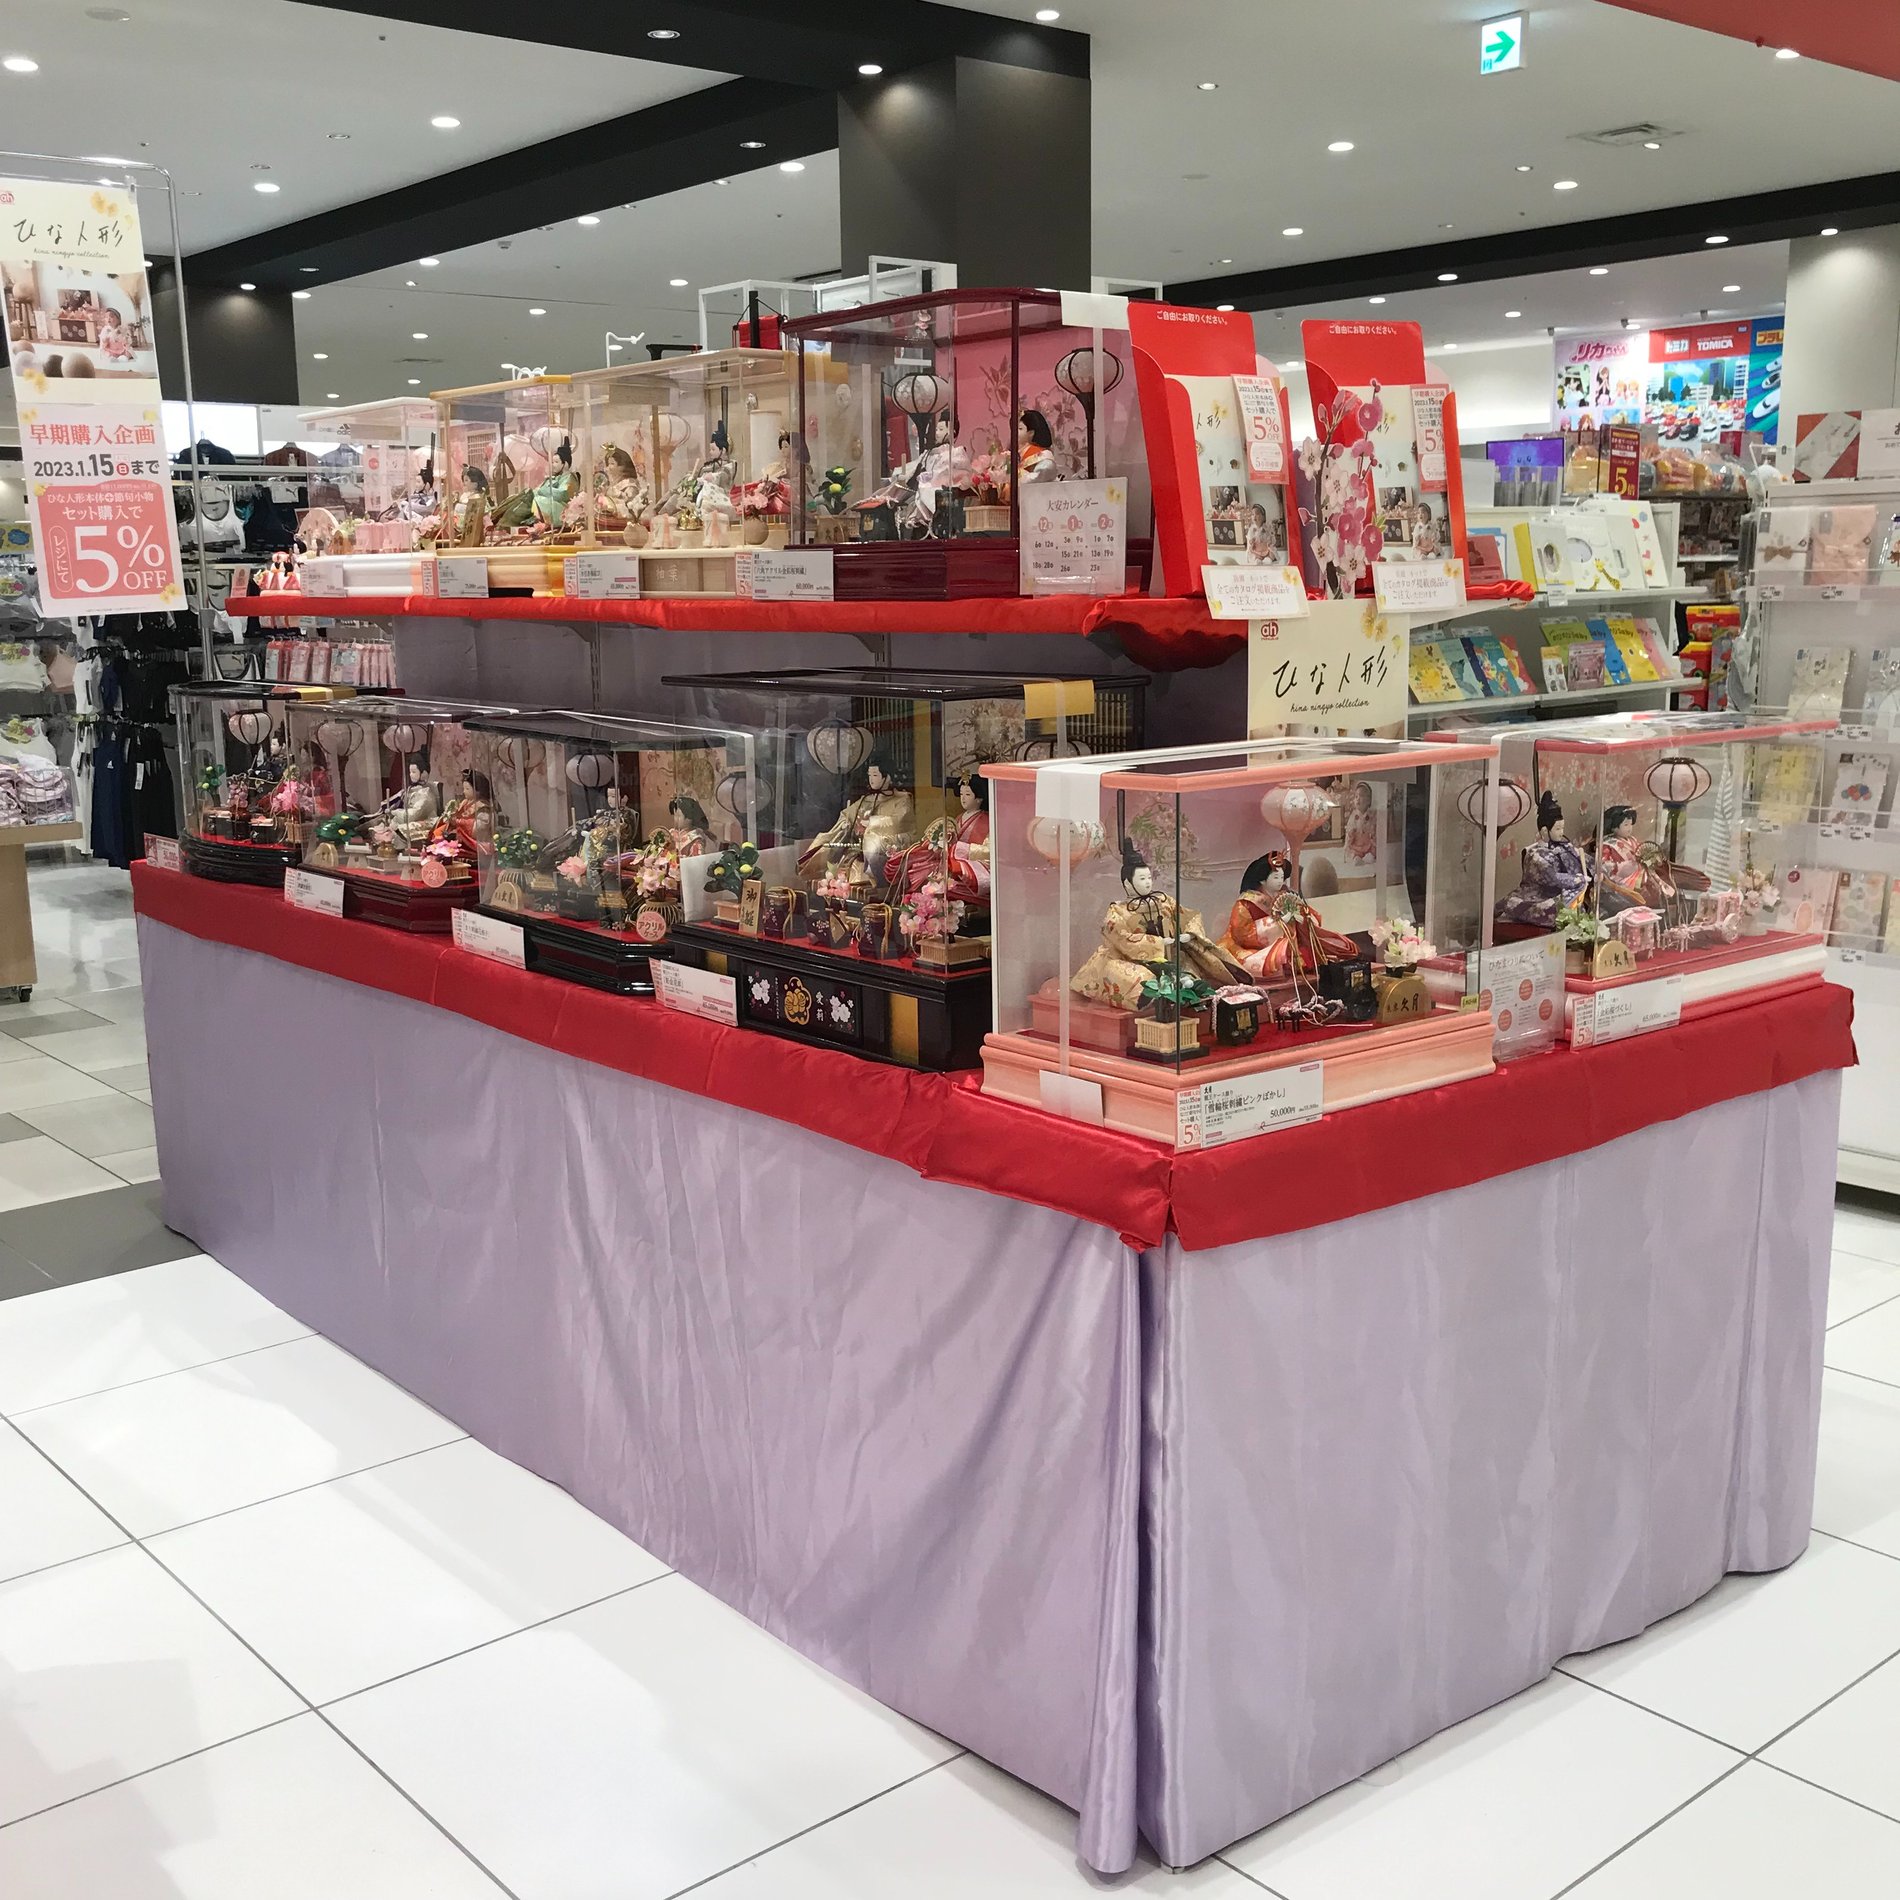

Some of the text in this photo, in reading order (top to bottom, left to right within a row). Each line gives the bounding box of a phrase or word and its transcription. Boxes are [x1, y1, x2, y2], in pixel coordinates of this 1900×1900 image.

[14, 218, 123, 247] ひな人形
[1156, 310, 1228, 325] ご自由にお取りください。
[1328, 323, 1397, 335] ご自由にお取りください。
[1570, 341, 1628, 363] リカちゃん
[1665, 338, 1690, 354] トミカ
[1697, 340, 1733, 351] TOMICA
[30, 424, 156, 445] 早期購入企画
[1253, 416, 1280, 440] 5%
[62, 505, 143, 520] セット購入で
[1047, 498, 1099, 512] 大安カレンダー
[53, 535, 68, 583] レジにて
[74, 525, 165, 593] 5%
[123, 571, 167, 590] OFF
[1261, 622, 1279, 638] ah
[1272, 645, 1388, 698] ひな人形
[1290, 698, 1369, 715] hina ningyo collection
[638, 921, 665, 931] アクリル
[1270, 1106, 1296, 1119] 50,000円
